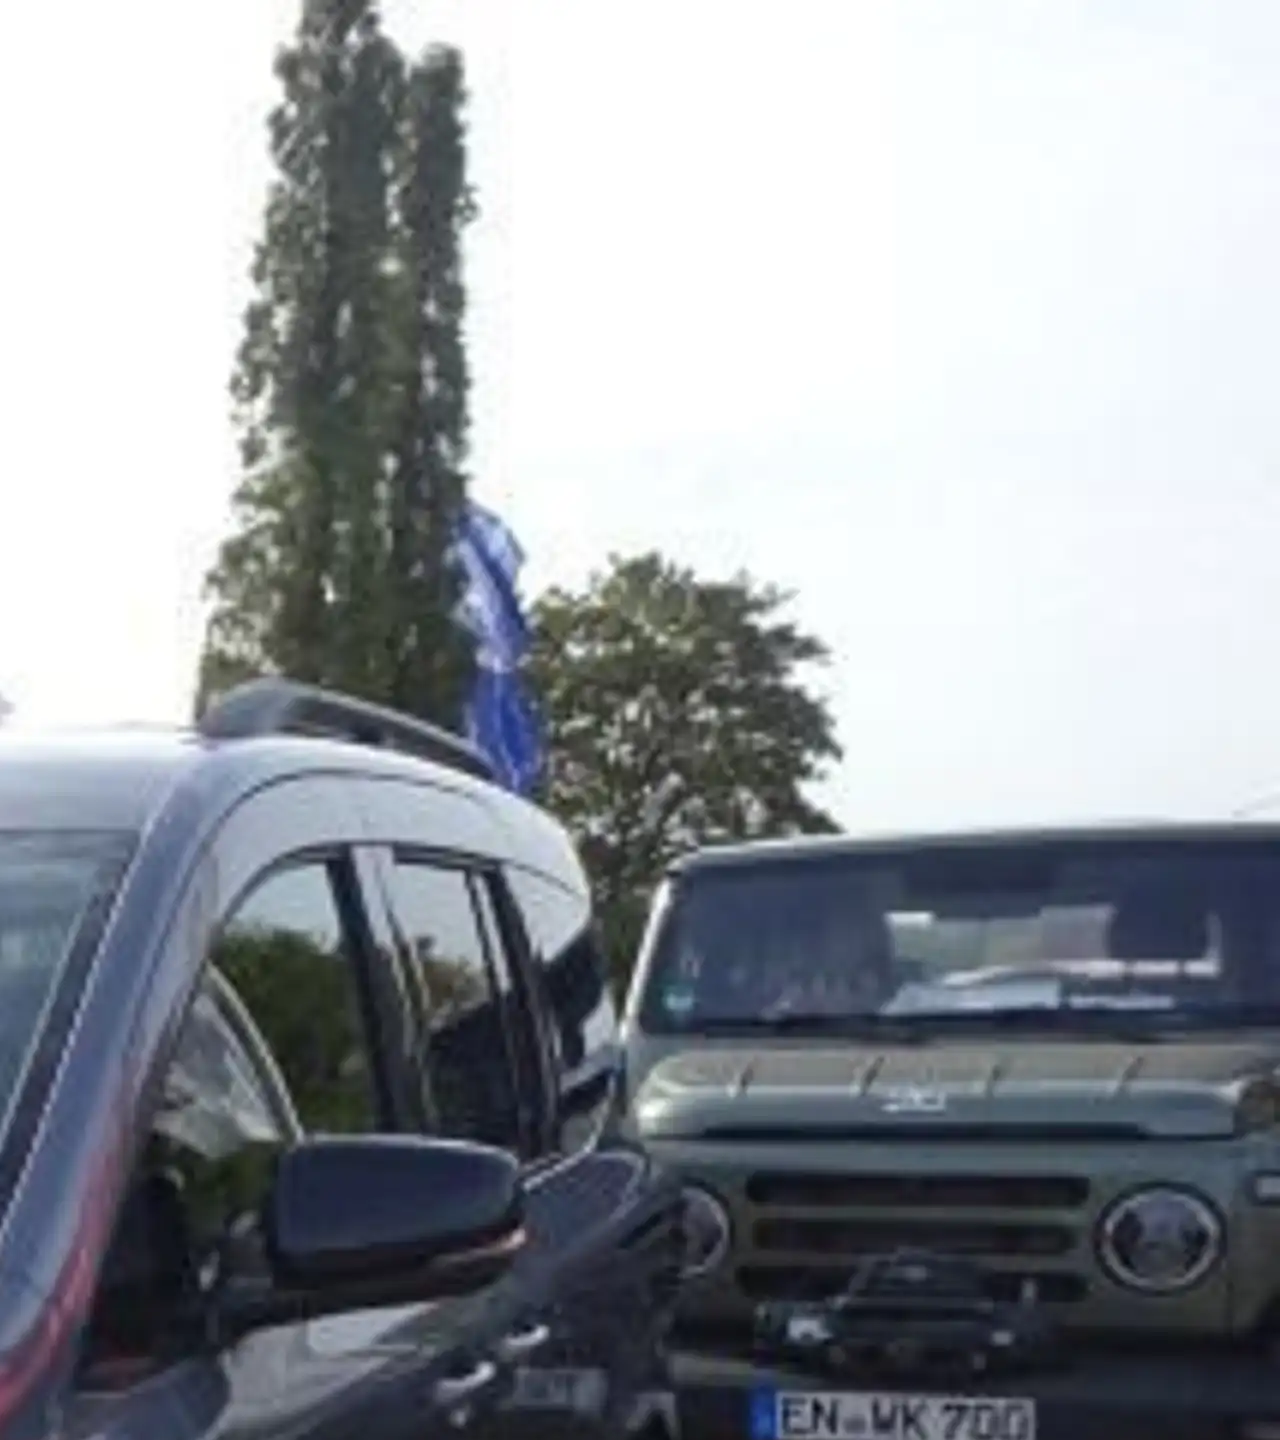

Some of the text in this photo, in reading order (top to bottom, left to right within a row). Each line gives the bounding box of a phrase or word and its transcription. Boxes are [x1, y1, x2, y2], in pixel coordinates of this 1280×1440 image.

[781, 1397, 1031, 1440] EN WK 700
